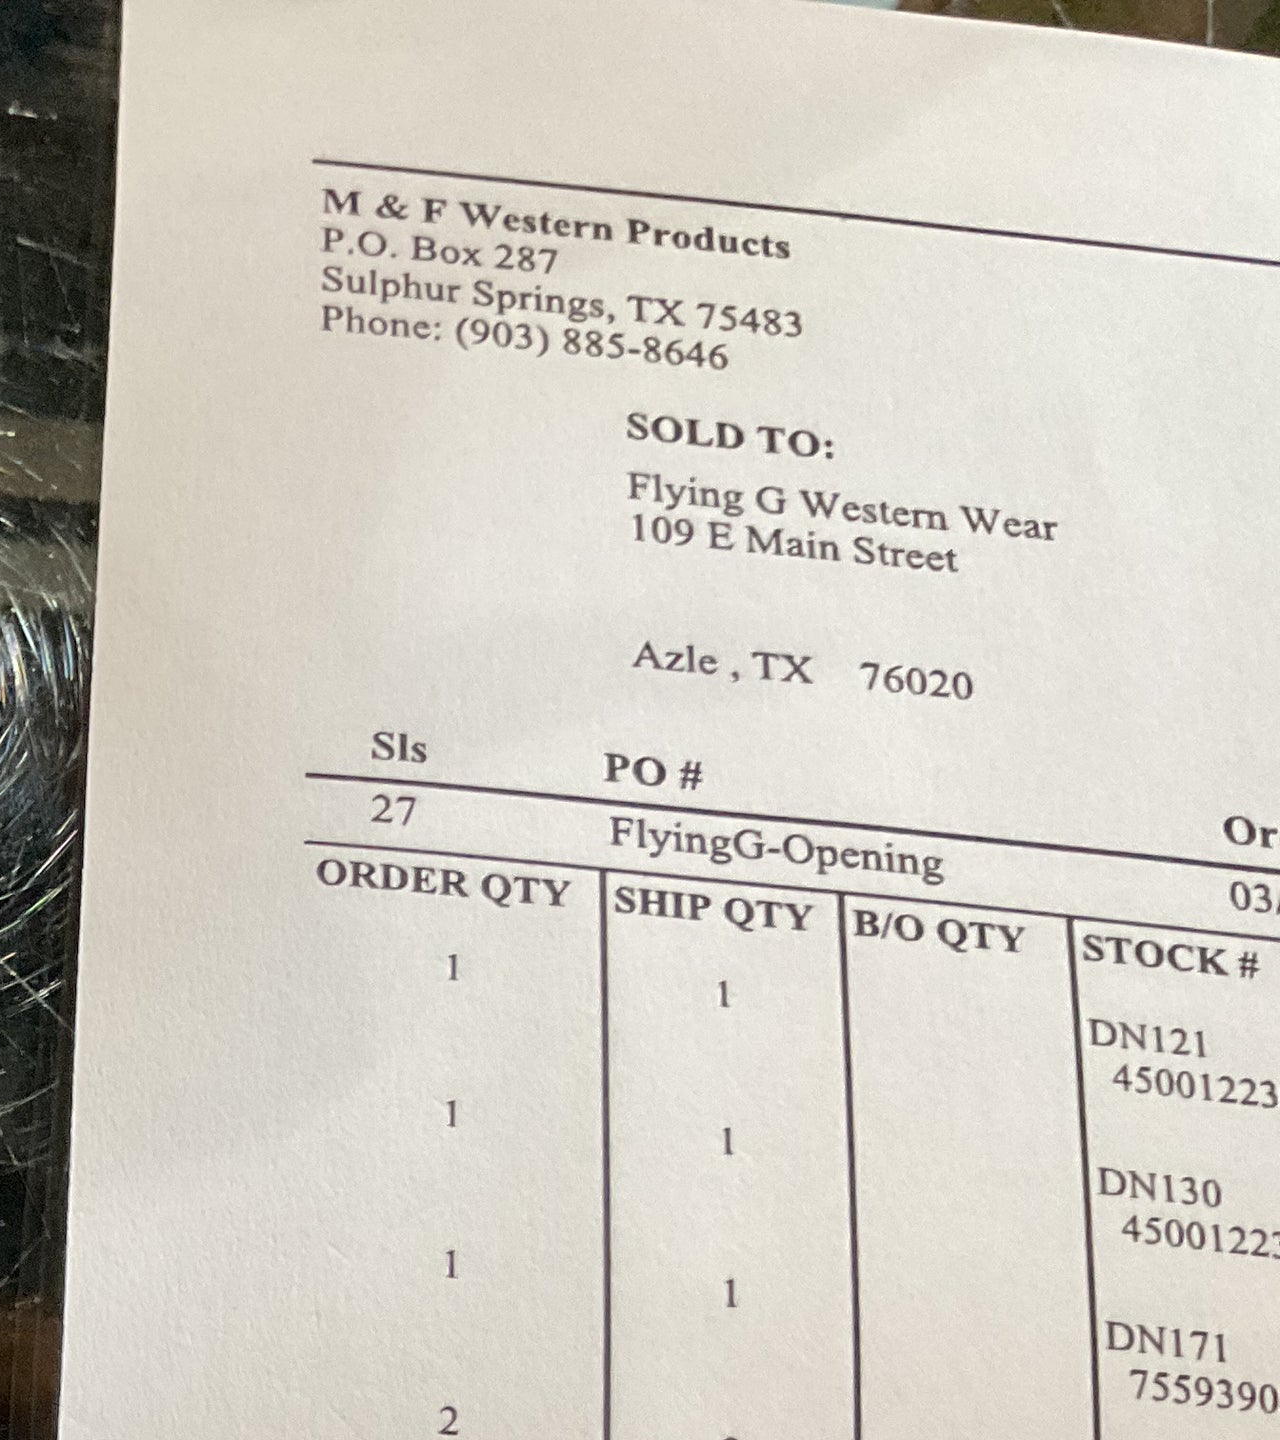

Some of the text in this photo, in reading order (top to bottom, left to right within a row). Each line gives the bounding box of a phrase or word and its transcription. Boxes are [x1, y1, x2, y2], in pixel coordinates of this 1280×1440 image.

[321, 187, 791, 260] M & F Western Products
[322, 226, 558, 275] P.O. Box 287
[321, 265, 803, 338] Sulphur Springs, TX 75483
[321, 303, 729, 371] Phone: (903) 885-8646
[626, 411, 835, 460] SOLD TO:
[626, 470, 1059, 542] Flying G Western Wear
[632, 513, 960, 573] 109 E Main Street
[631, 639, 719, 676] Azle
[749, 650, 814, 685] TX
[859, 661, 974, 701] 76020
[371, 730, 428, 764] Sls
[603, 752, 704, 791] PO #
[370, 793, 417, 827] 27
[1222, 815, 1279, 849] Or
[609, 816, 945, 887] FlyingG-Opening
[315, 858, 572, 909] ORDER QTY
[614, 885, 814, 933] SHIP QTY
[852, 909, 1026, 954] B/O QTY
[447, 953, 459, 982] 1
[1082, 933, 1261, 980] STOCK #
[718, 979, 731, 1009] 1
[1088, 1017, 1207, 1059] DN121
[445, 1099, 457, 1129] 1
[722, 1126, 735, 1157] 1
[1097, 1166, 1222, 1209] DN130
[445, 1248, 459, 1280] 1
[724, 1277, 738, 1309] 1
[1104, 1320, 1227, 1364] DN171
[437, 1405, 460, 1437] 2
